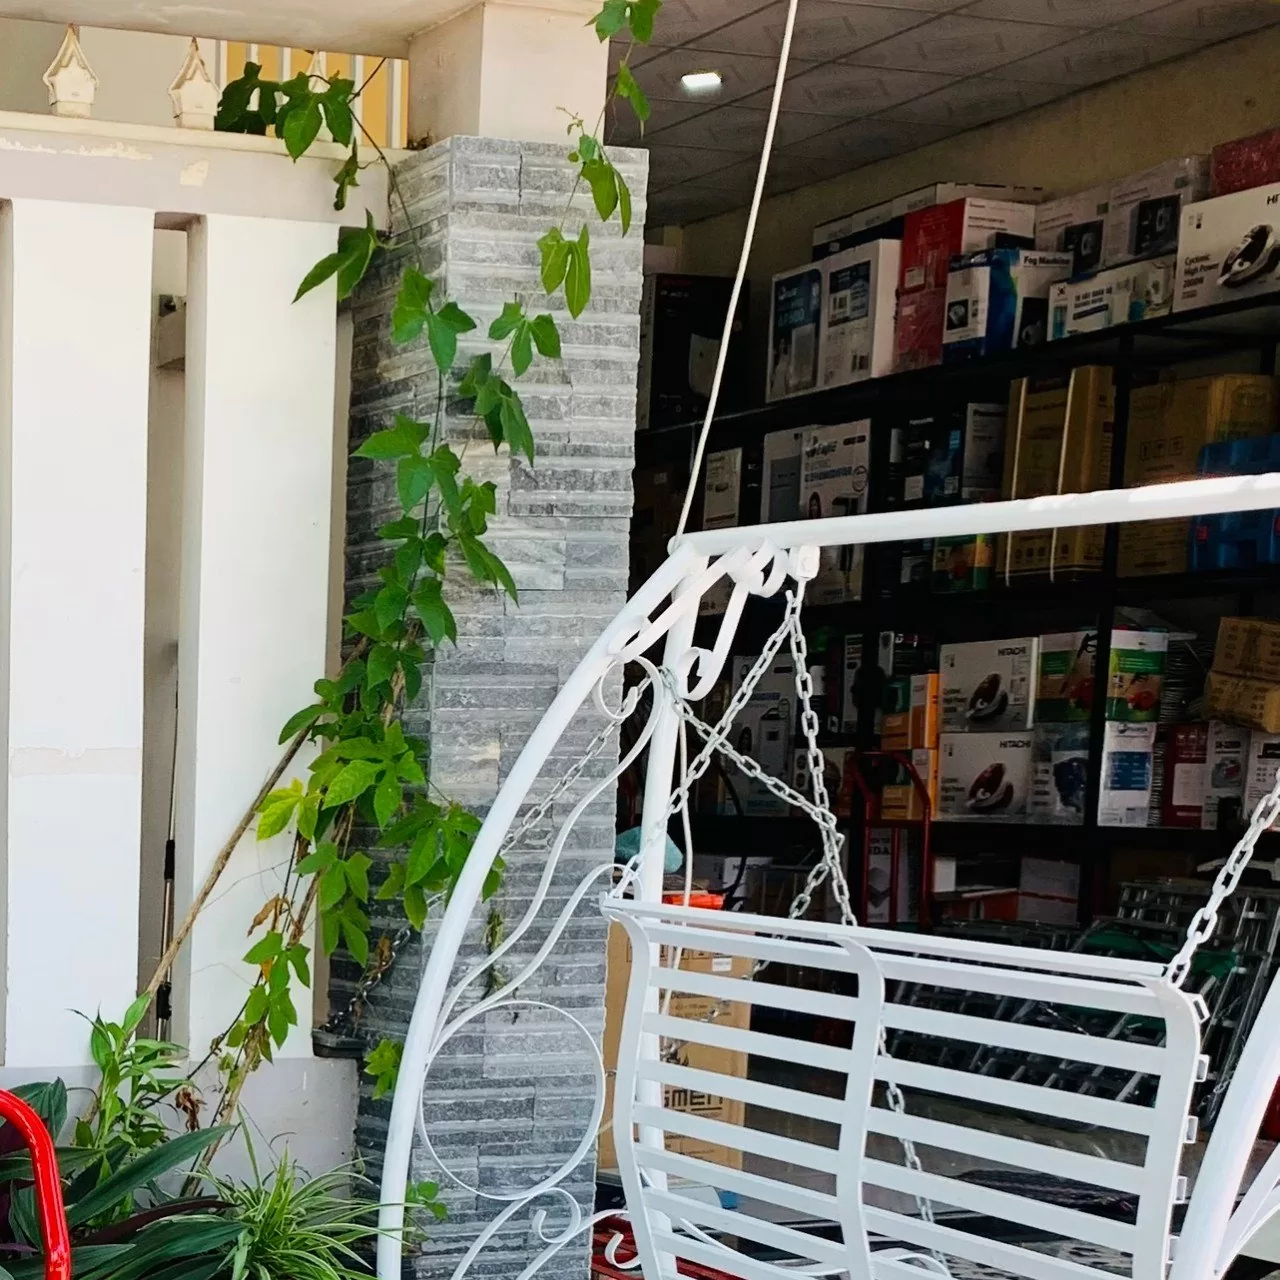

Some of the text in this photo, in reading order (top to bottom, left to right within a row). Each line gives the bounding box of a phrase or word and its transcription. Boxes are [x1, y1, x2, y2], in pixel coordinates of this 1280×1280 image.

[1267, 193, 1280, 205] HI
[1023, 256, 1037, 266] Fog
[998, 647, 1026, 656] HITACHI
[1000, 740, 1031, 748] HITACHI
